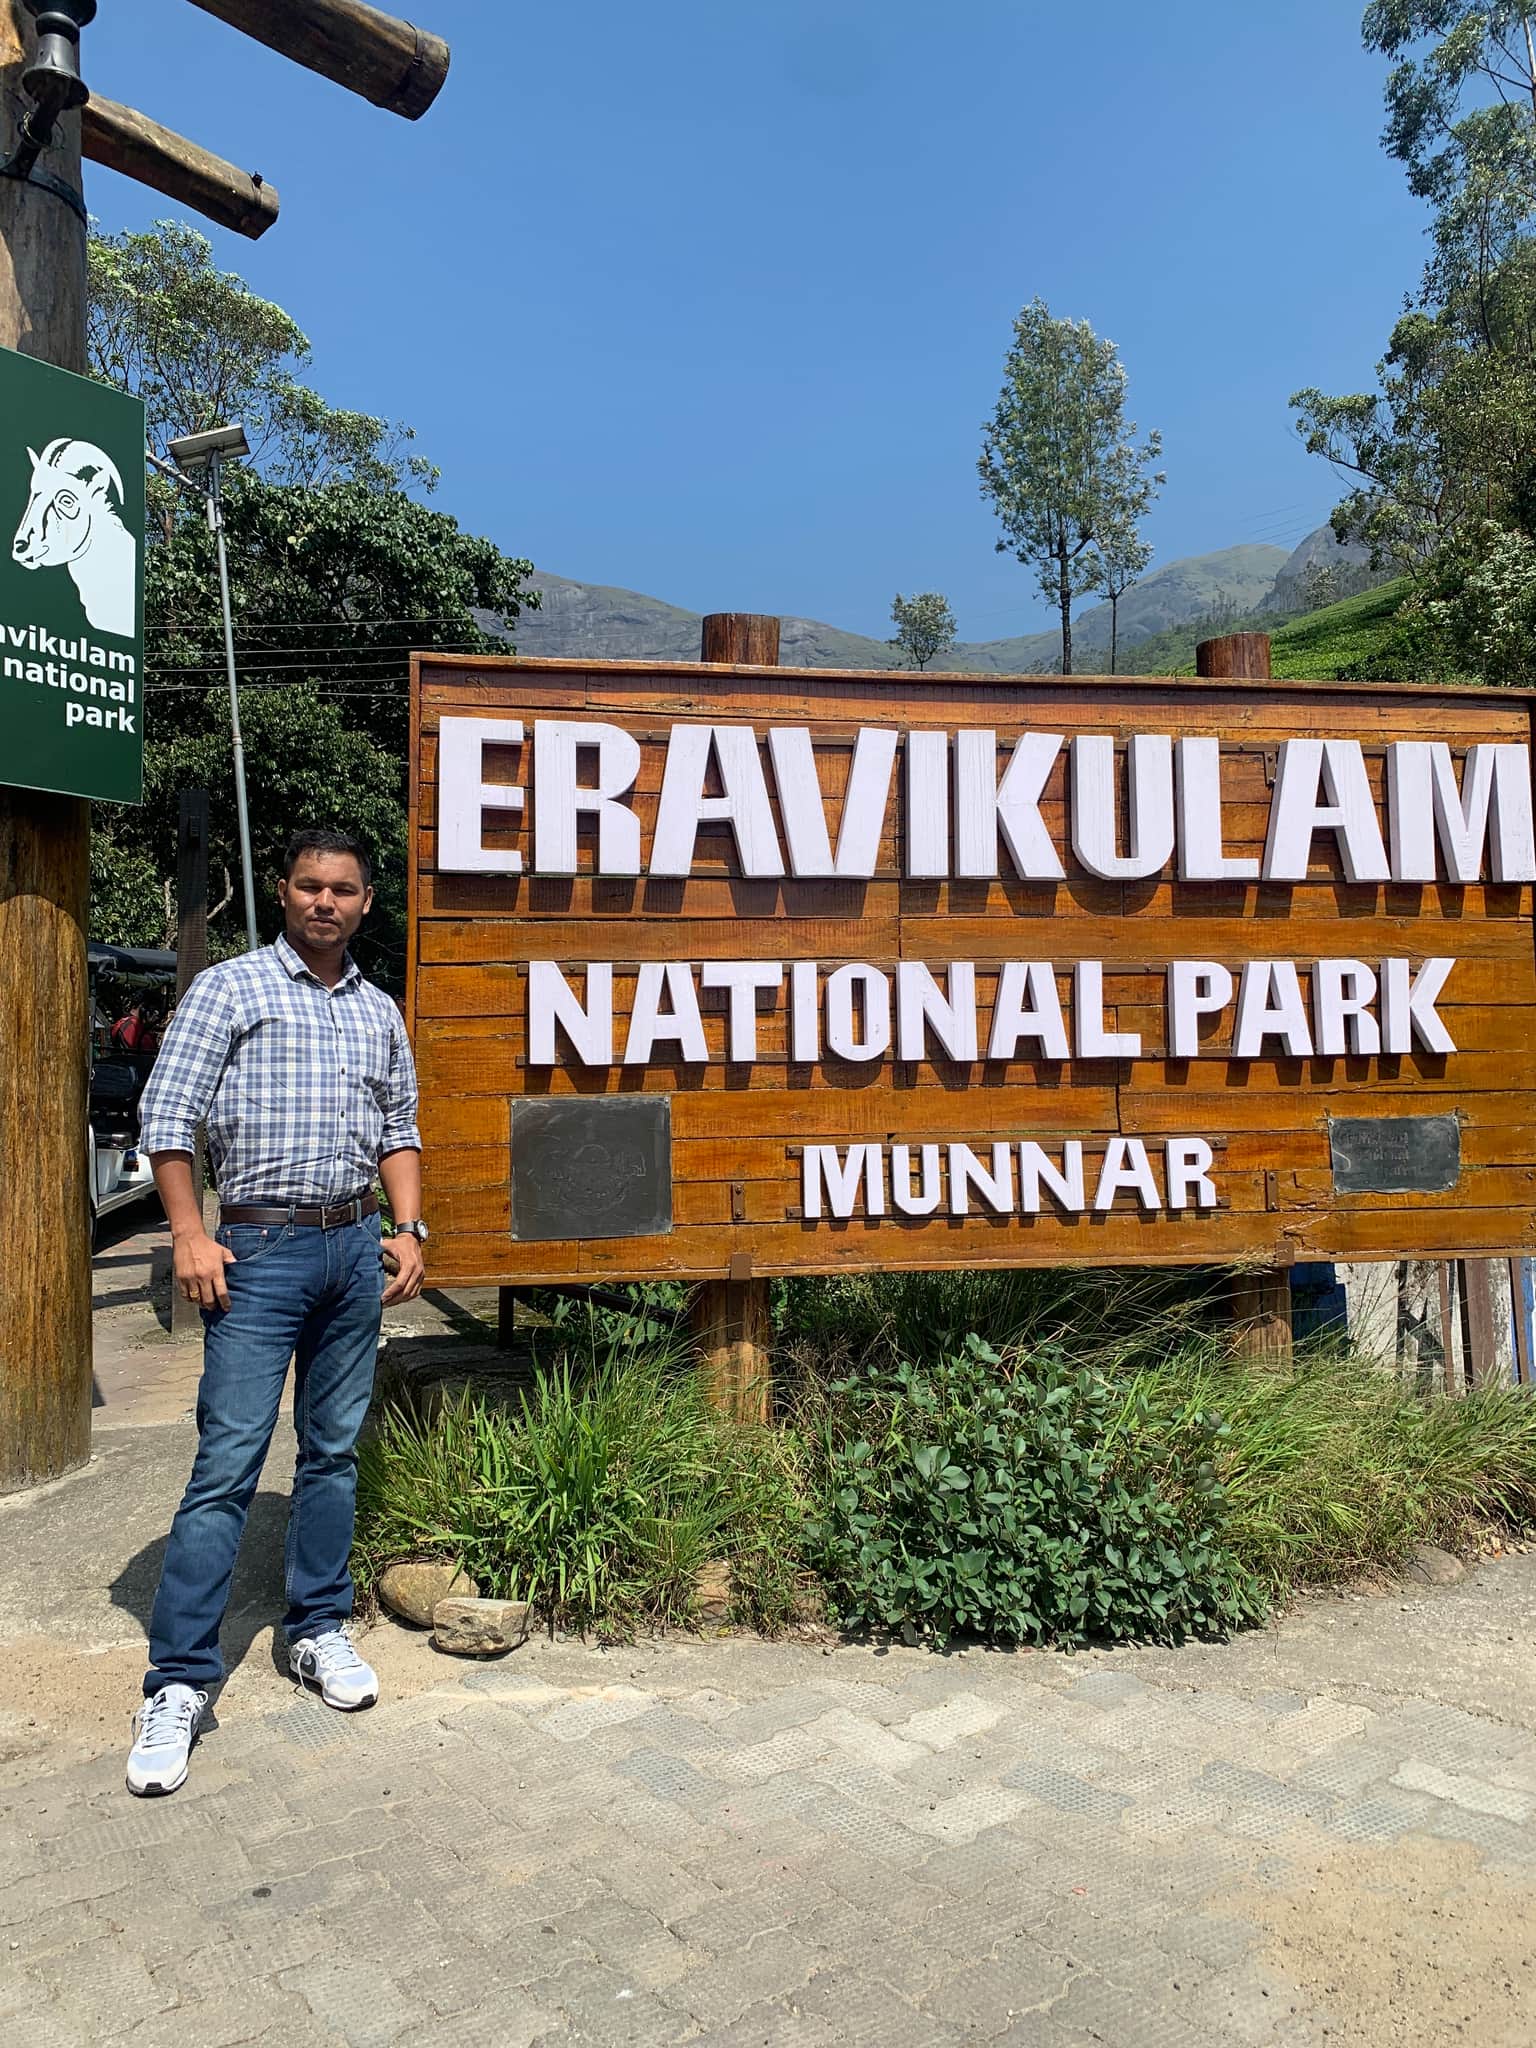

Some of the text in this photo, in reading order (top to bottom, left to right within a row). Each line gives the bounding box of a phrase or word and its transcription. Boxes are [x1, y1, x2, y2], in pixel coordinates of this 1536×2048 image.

[4, 656, 135, 704] national
[66, 701, 136, 734] park
[438, 716, 1536, 883] ERAVIKULAM
[528, 958, 1457, 1066] NATIONAL PARK
[803, 1137, 1217, 1219] MUNNAR
